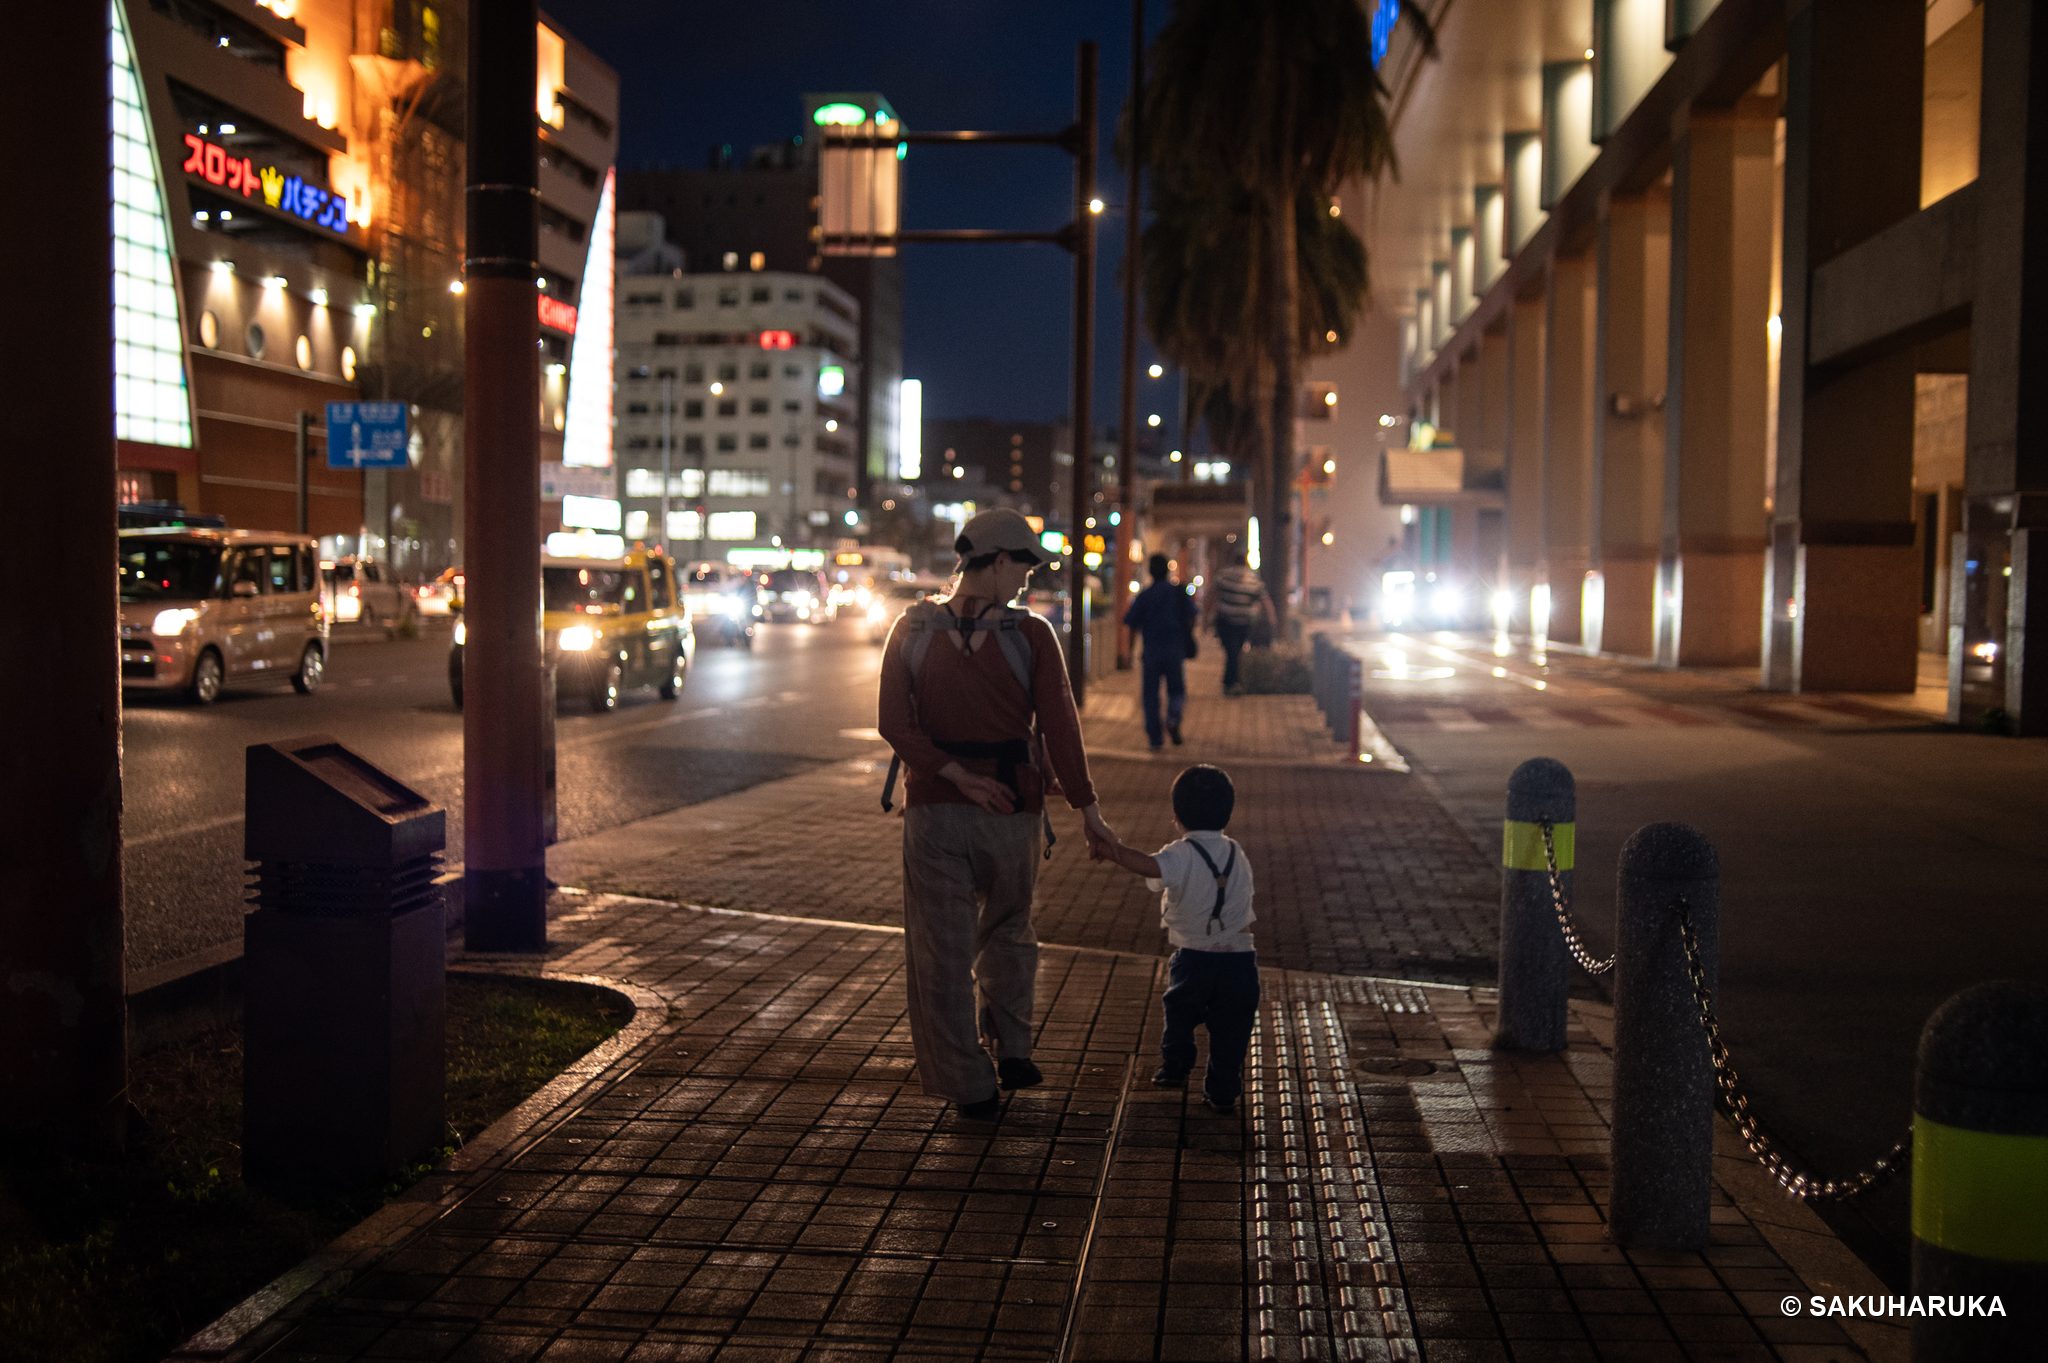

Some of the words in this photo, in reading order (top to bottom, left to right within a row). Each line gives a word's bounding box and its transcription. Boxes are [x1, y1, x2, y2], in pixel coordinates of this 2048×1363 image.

[184, 133, 261, 198] スロット
[281, 175, 349, 233] パチンコ
